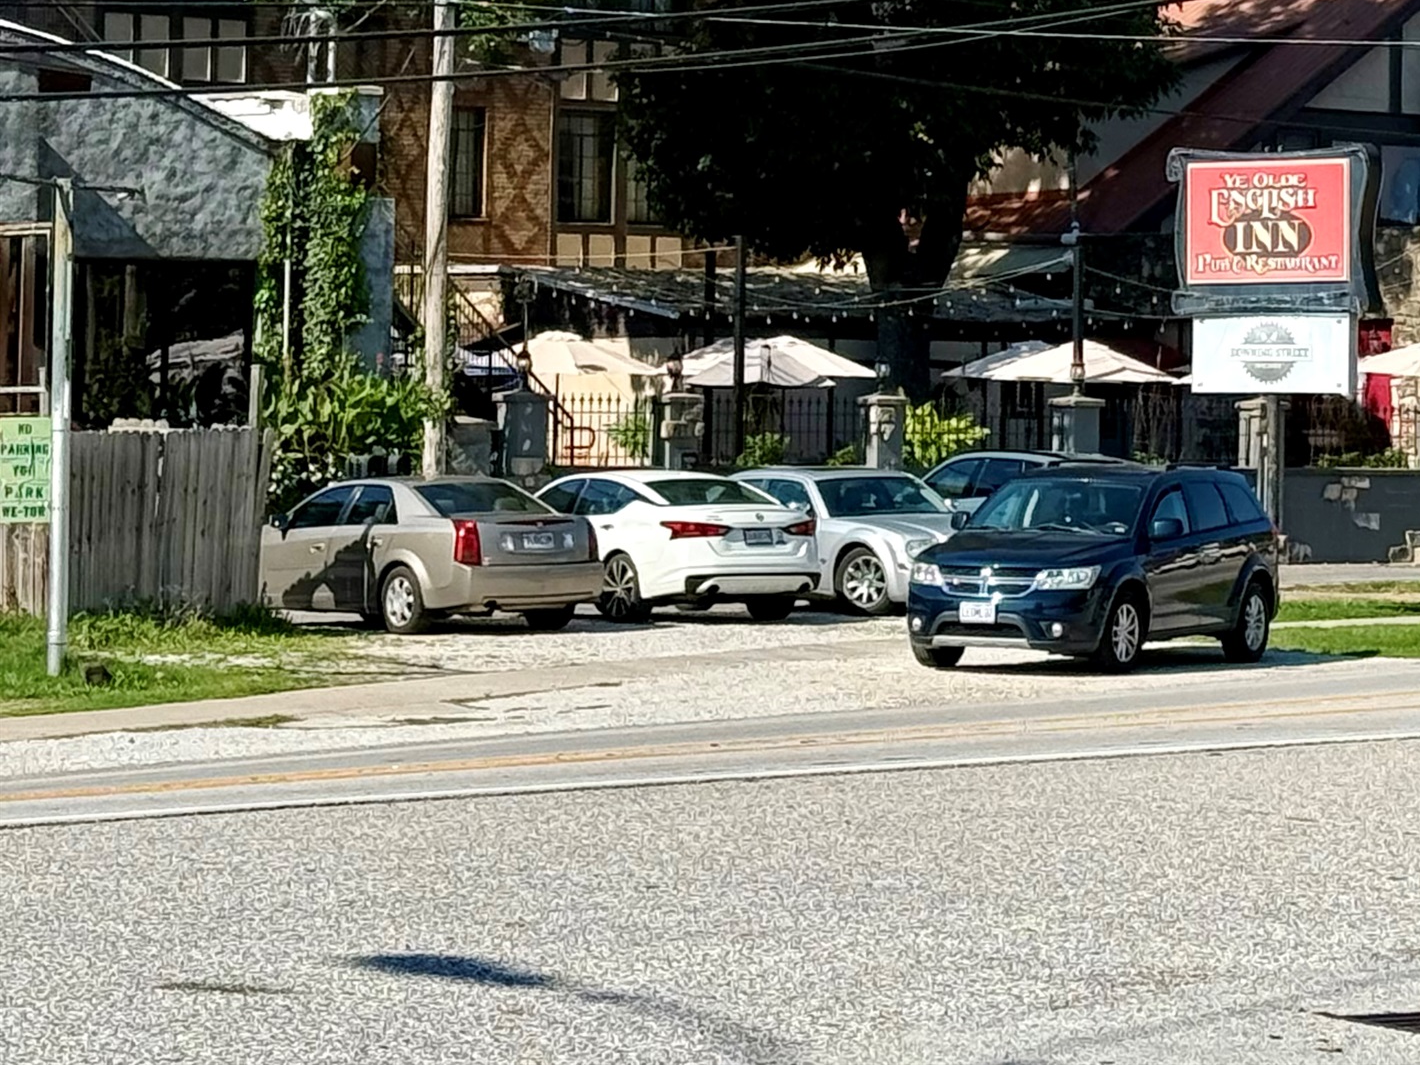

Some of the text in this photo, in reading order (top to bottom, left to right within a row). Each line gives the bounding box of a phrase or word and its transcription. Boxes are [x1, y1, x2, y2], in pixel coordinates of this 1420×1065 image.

[1208, 188, 1317, 226] ENGLISH
[1233, 220, 1302, 253] INN
[1276, 348, 1310, 358] STREET
[18, 423, 32, 435] NO
[1, 443, 49, 455] PARKING
[4, 486, 44, 499] PARK
